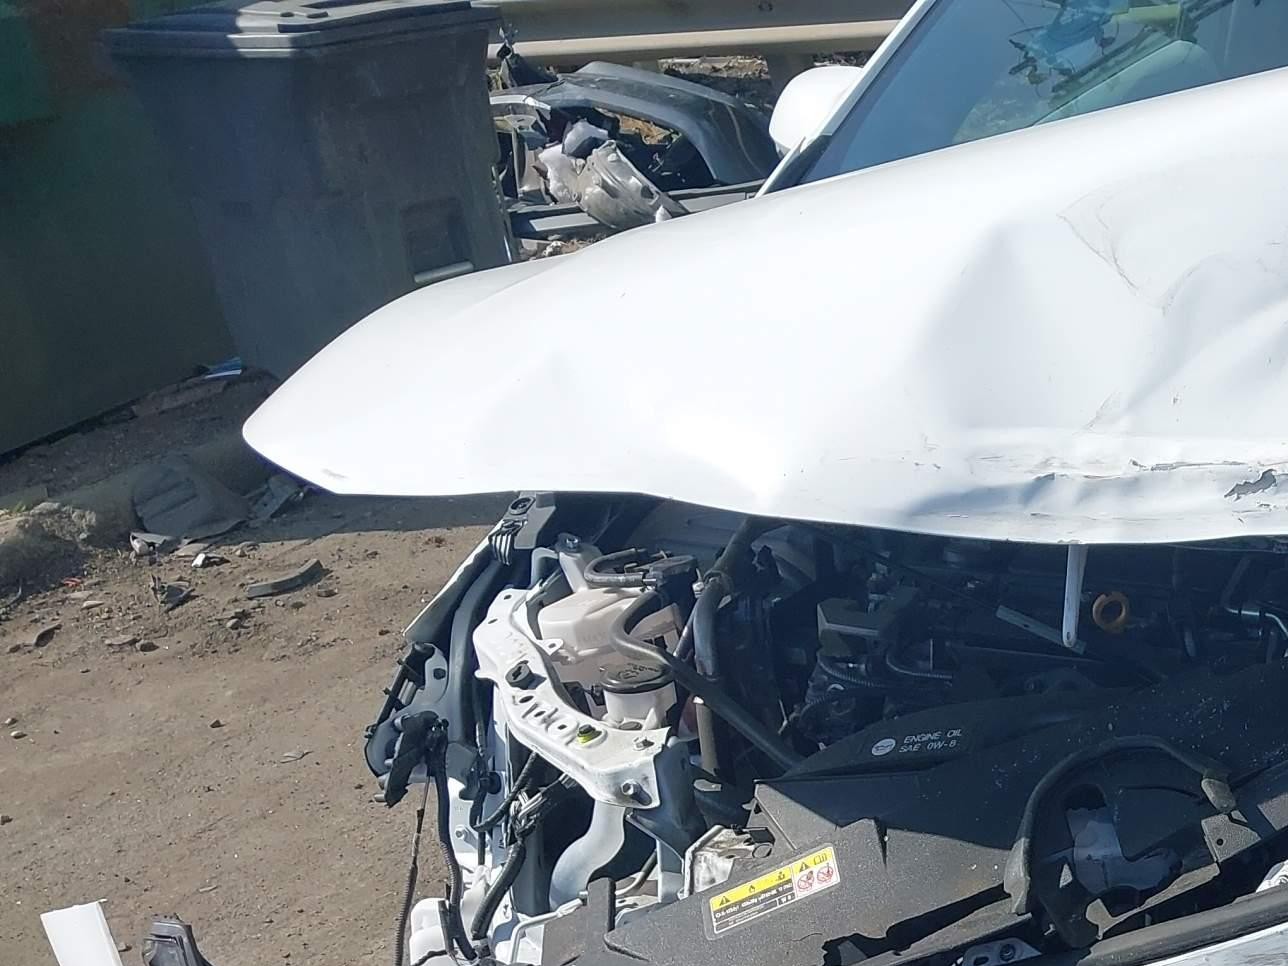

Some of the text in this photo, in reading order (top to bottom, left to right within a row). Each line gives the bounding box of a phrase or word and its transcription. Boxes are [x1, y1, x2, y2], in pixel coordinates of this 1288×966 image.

[903, 728, 962, 744] ENGINE OIL
[898, 743, 921, 753] SAE
